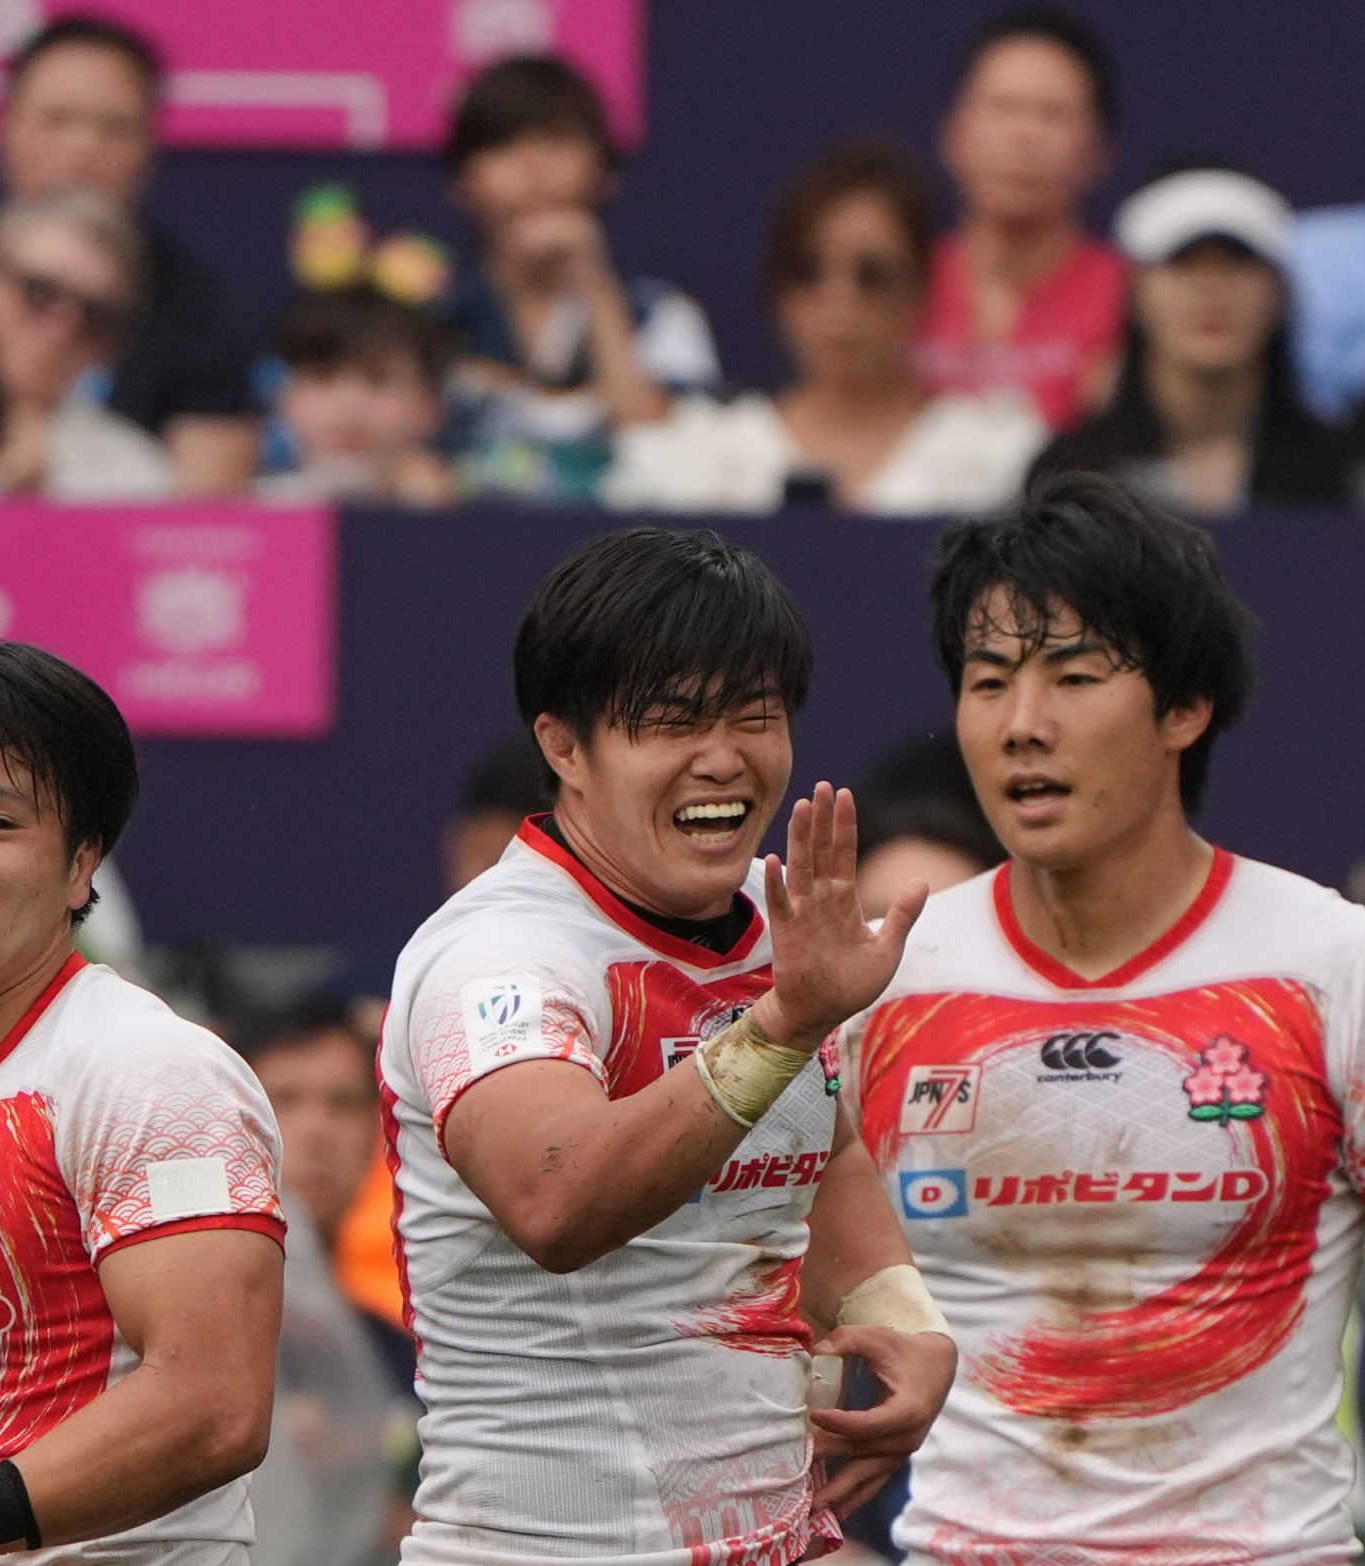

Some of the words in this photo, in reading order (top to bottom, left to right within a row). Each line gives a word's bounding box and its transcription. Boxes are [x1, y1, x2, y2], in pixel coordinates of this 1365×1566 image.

[1037, 1070, 1123, 1084] canterbury
[974, 1169, 1266, 1207] リポビタンD
